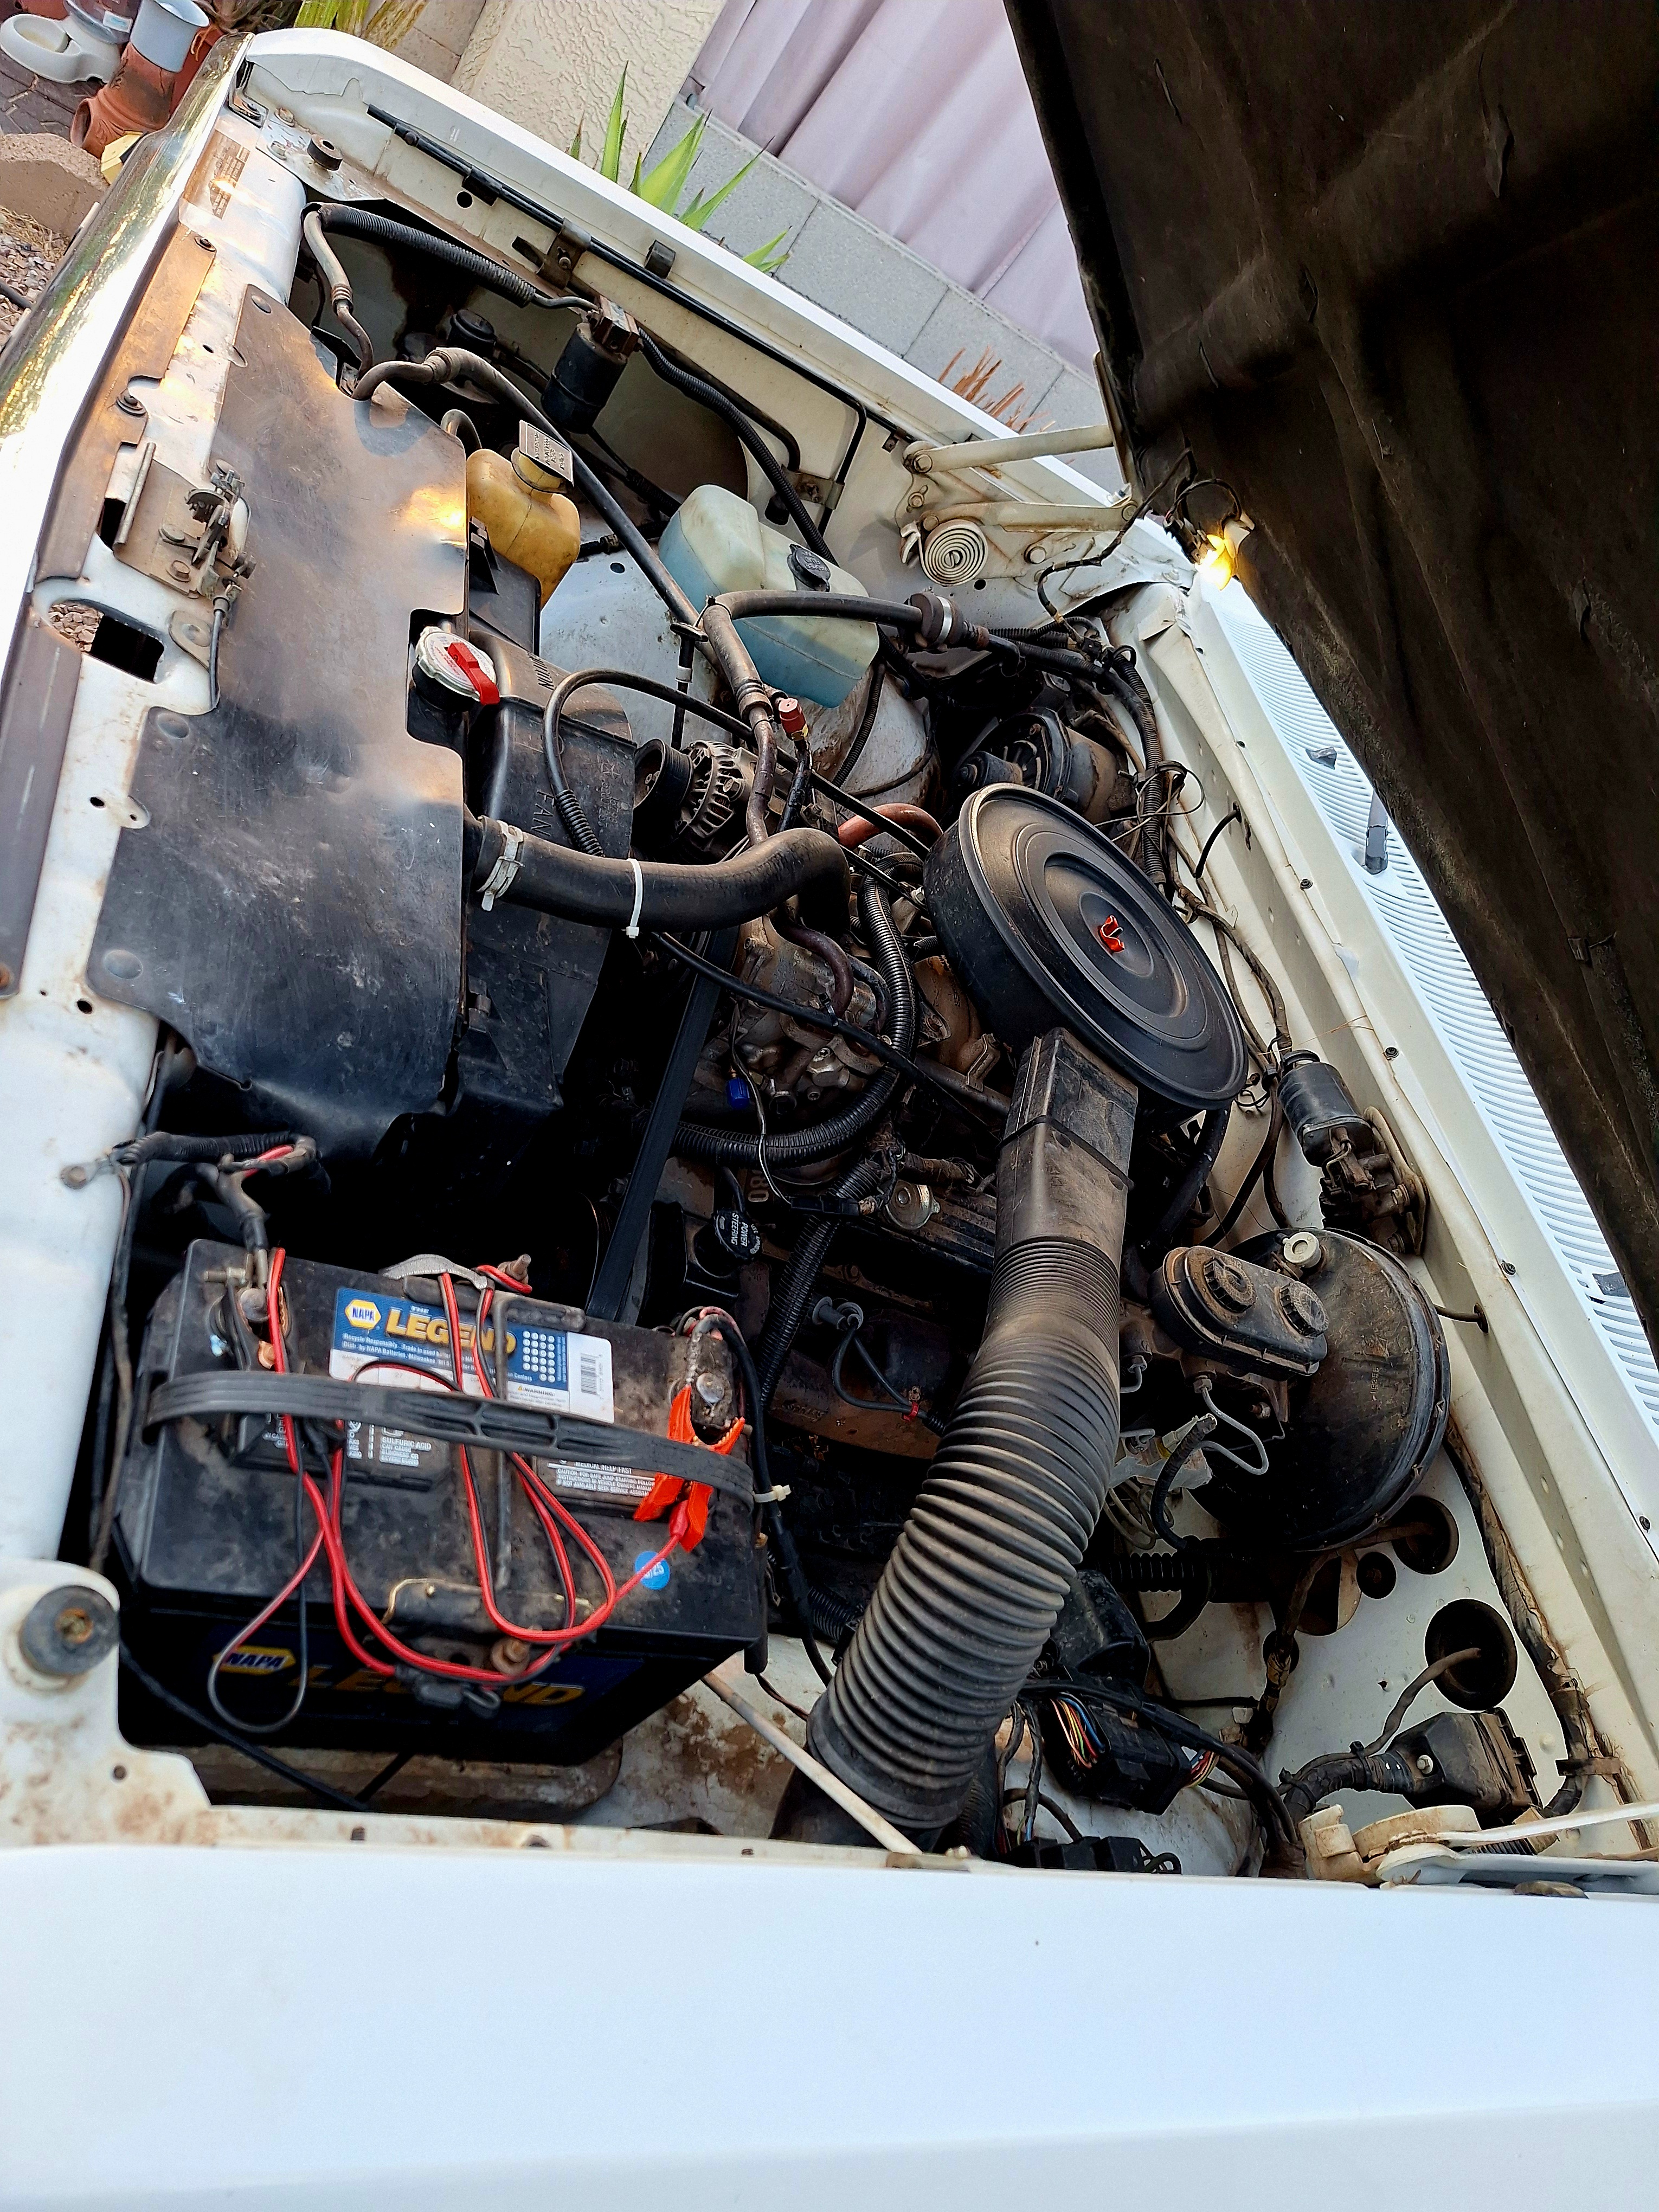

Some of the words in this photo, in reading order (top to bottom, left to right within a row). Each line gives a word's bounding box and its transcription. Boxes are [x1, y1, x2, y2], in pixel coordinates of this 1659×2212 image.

[531, 789, 557, 837] FAN
[731, 1212, 740, 1245] STEERING
[740, 1221, 748, 1247] POWER
[352, 1307, 375, 1321] NAPA
[343, 1333, 365, 1342] Recycle
[366, 1345, 382, 1354] NAPA
[381, 1436, 415, 1448] SULFURIC
[415, 1441, 432, 1451] ACID
[575, 1461, 601, 1470] MEDICAL
[601, 1464, 617, 1472] HELP
[618, 1466, 632, 1474] FAST
[227, 1651, 286, 1673] NAPA
